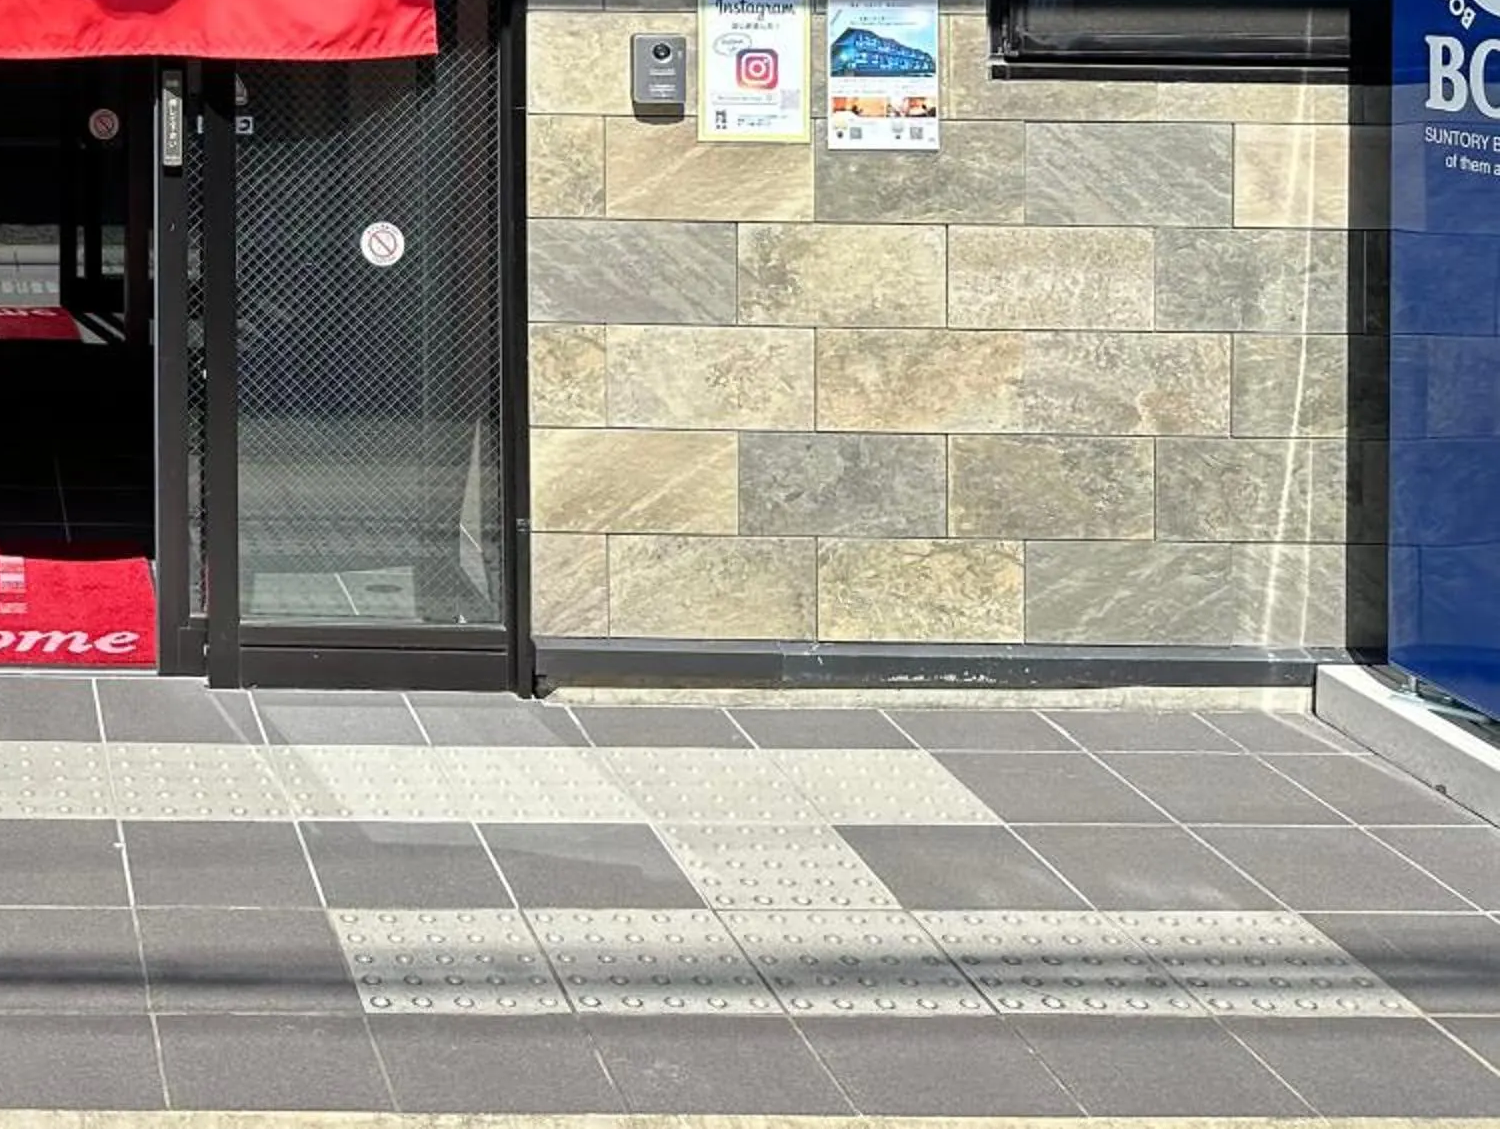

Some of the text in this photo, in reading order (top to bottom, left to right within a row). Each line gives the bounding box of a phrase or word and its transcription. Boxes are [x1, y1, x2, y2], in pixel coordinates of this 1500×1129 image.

[1425, 126, 1489, 151] SUNTORY
[1445, 154, 1457, 169] of
[1460, 157, 1490, 175] them
